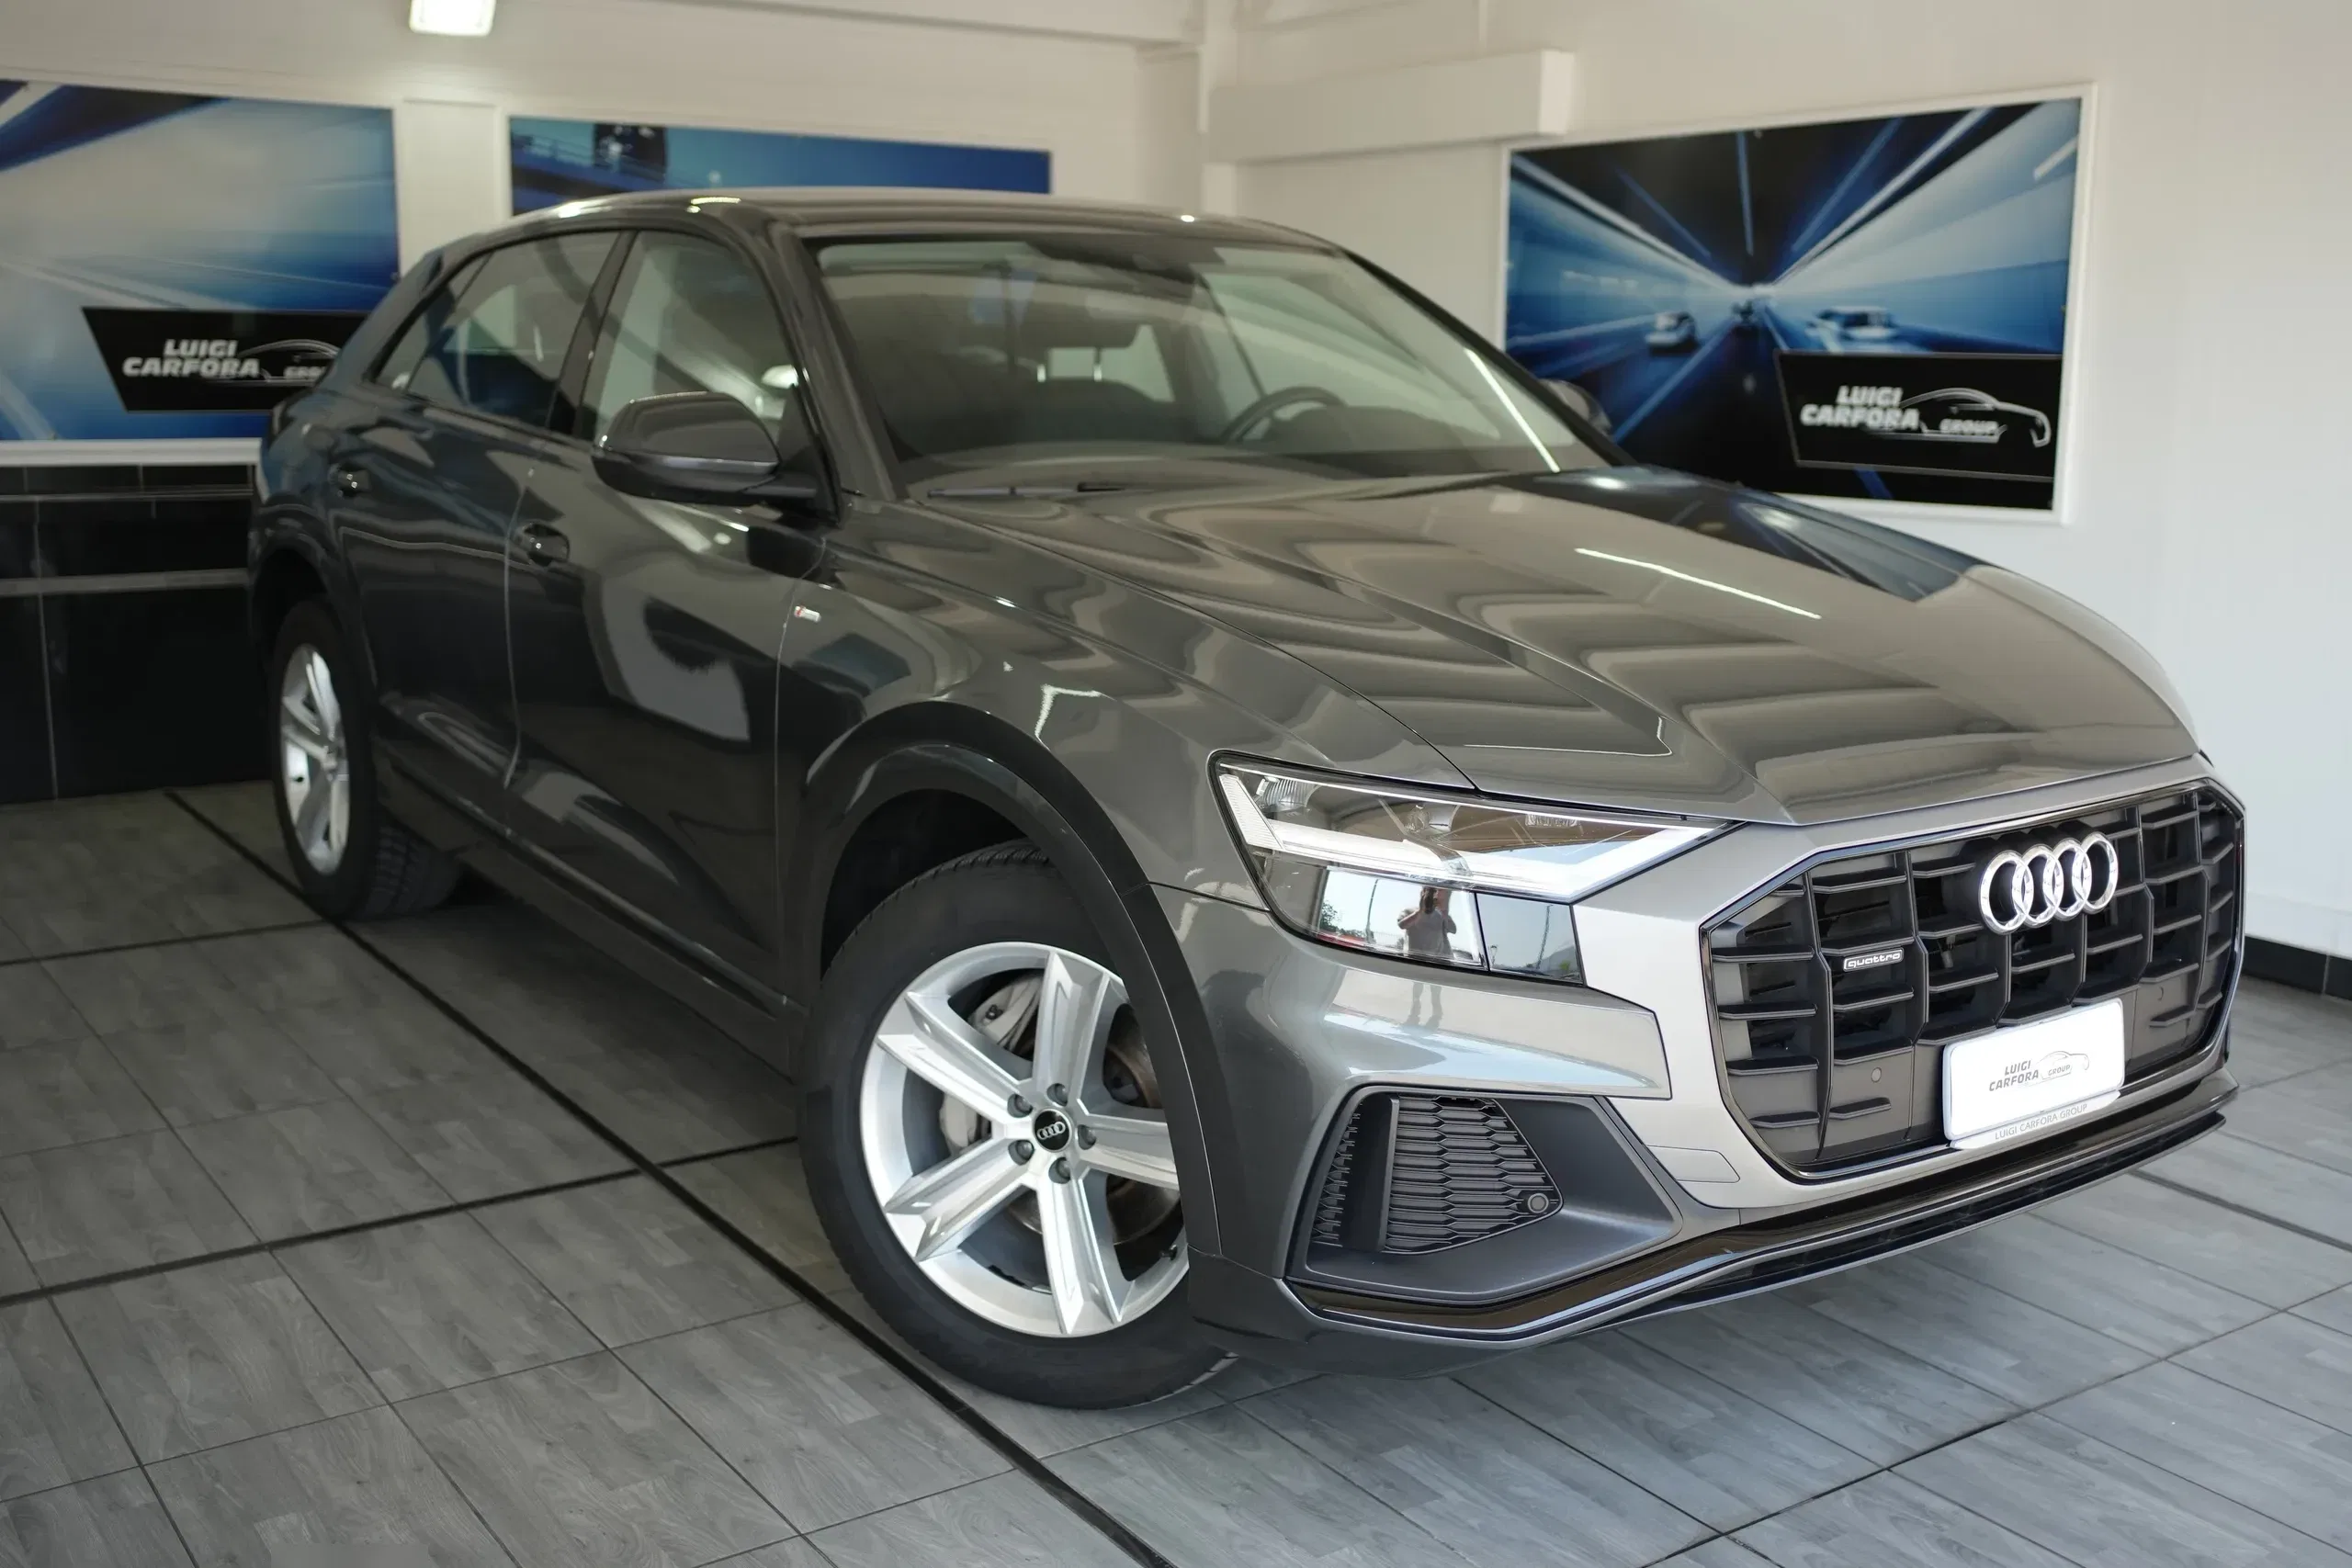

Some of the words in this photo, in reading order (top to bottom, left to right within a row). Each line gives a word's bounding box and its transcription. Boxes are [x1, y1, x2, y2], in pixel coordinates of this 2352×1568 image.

[163, 338, 238, 357] LUIGI
[122, 356, 260, 378] CARFORA
[1836, 385, 1903, 406] LUIGI
[1800, 403, 1920, 431] CARFORA
[1847, 952, 1901, 969] quattro
[1988, 1069, 2039, 1092] CARFORA
[2047, 1064, 2071, 1077] GROUP
[2004, 1060, 2031, 1077] LUIGI
[1995, 1126, 2018, 1140] LUIGI
[2019, 1112, 2058, 1132] CARFORA
[2059, 1103, 2087, 1119] GROUP
